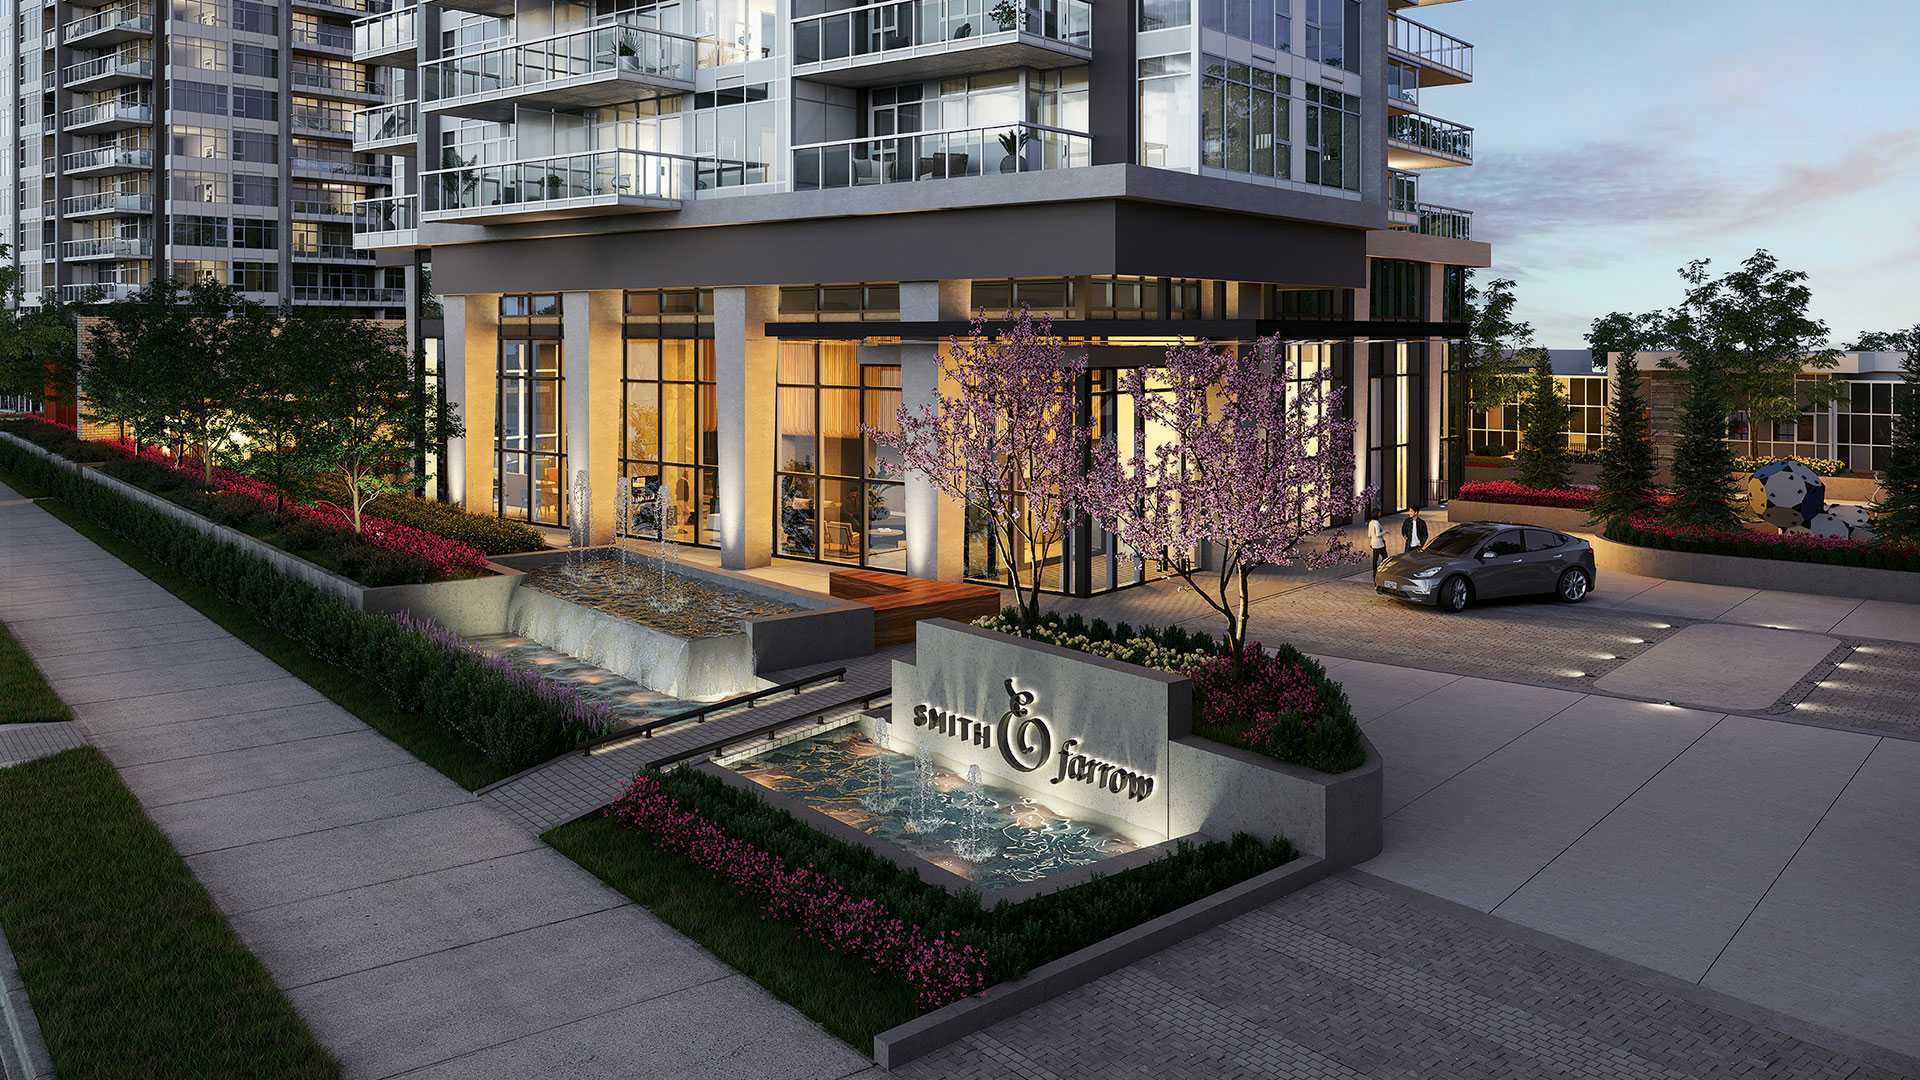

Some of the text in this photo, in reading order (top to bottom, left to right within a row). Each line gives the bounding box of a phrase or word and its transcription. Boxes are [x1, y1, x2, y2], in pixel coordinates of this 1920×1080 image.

[913, 678, 1155, 802] SMITH & farrow
